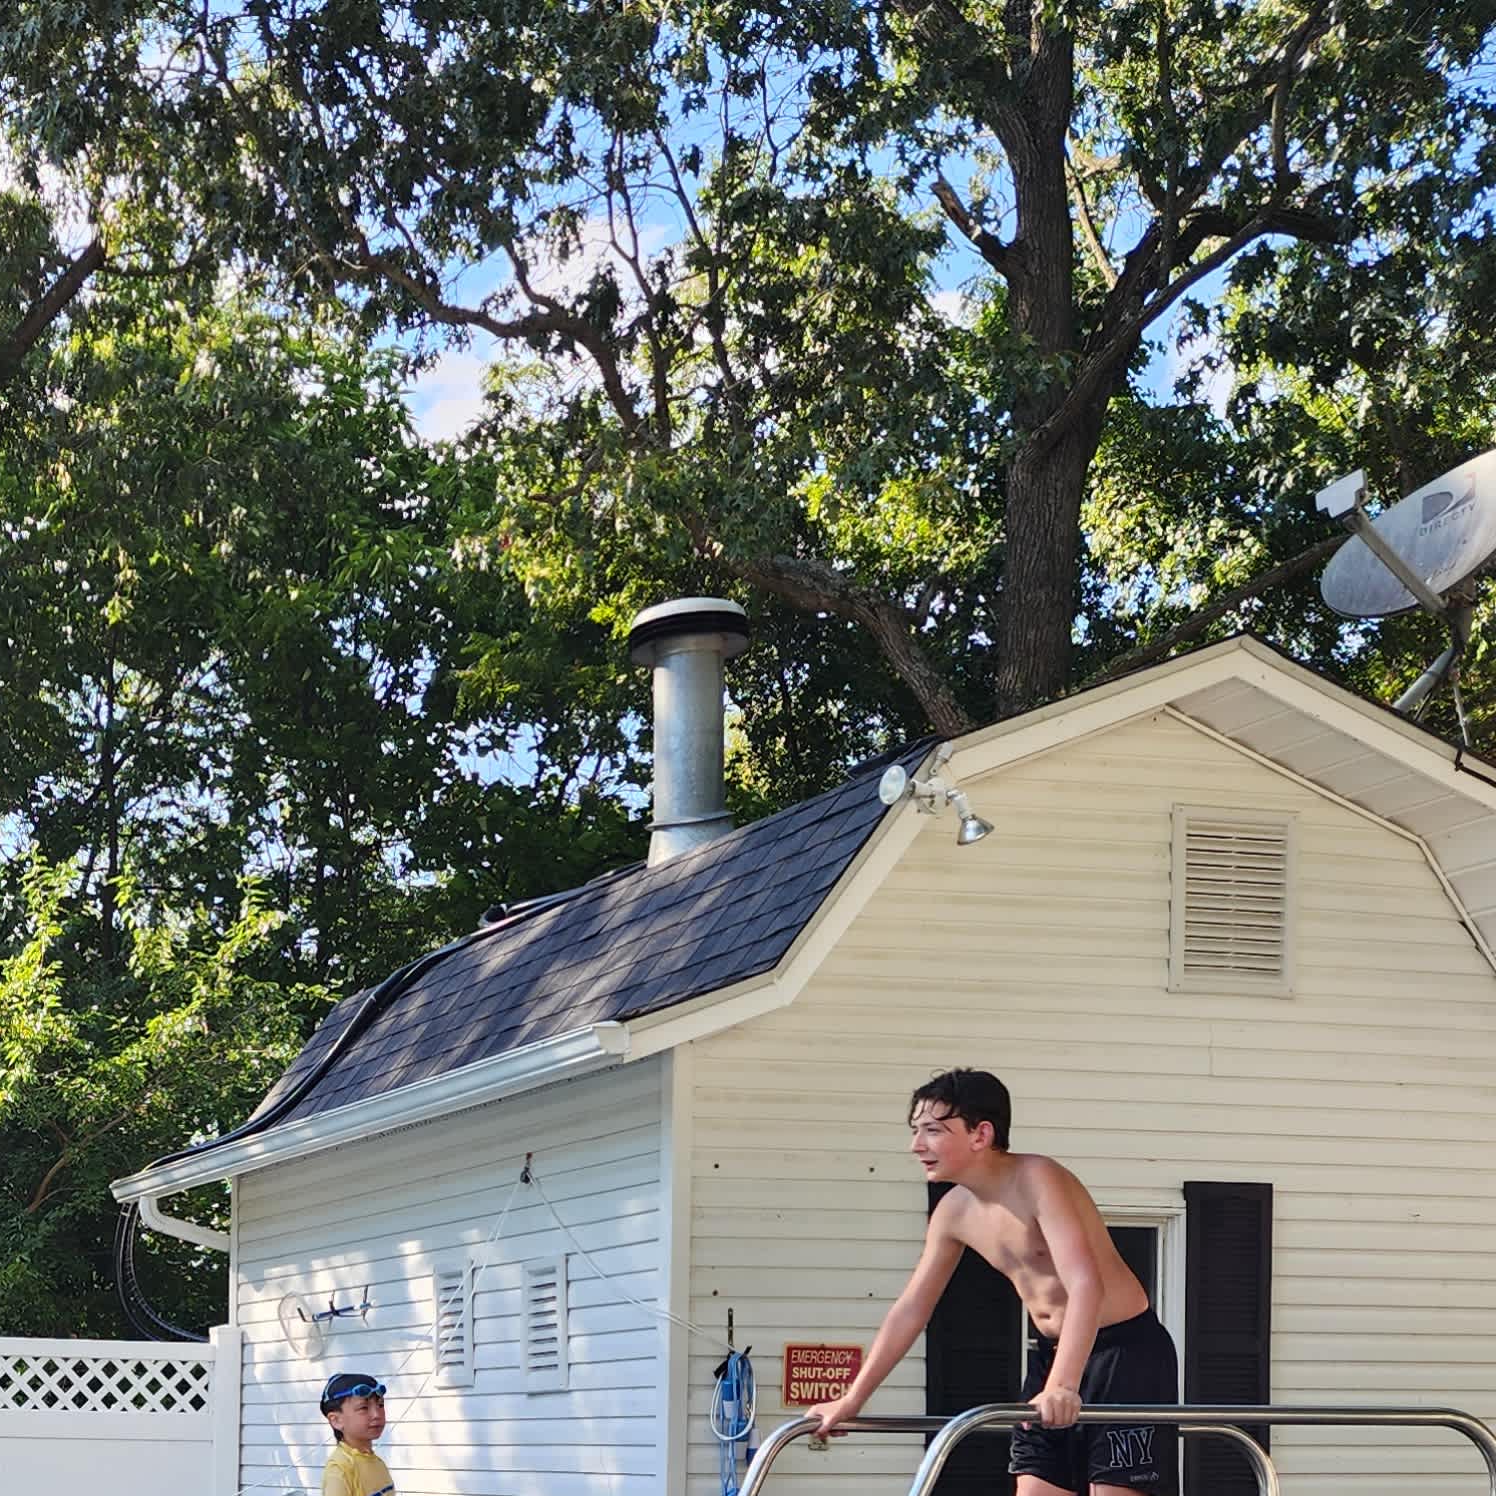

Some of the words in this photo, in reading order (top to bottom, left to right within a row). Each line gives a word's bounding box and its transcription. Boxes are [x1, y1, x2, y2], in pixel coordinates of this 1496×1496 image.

[1419, 503, 1475, 536] DIRECTV
[791, 1350, 854, 1364] EMERGENCY
[792, 1367, 851, 1379] SHUT-OFF
[1107, 1426, 1154, 1468] NY
